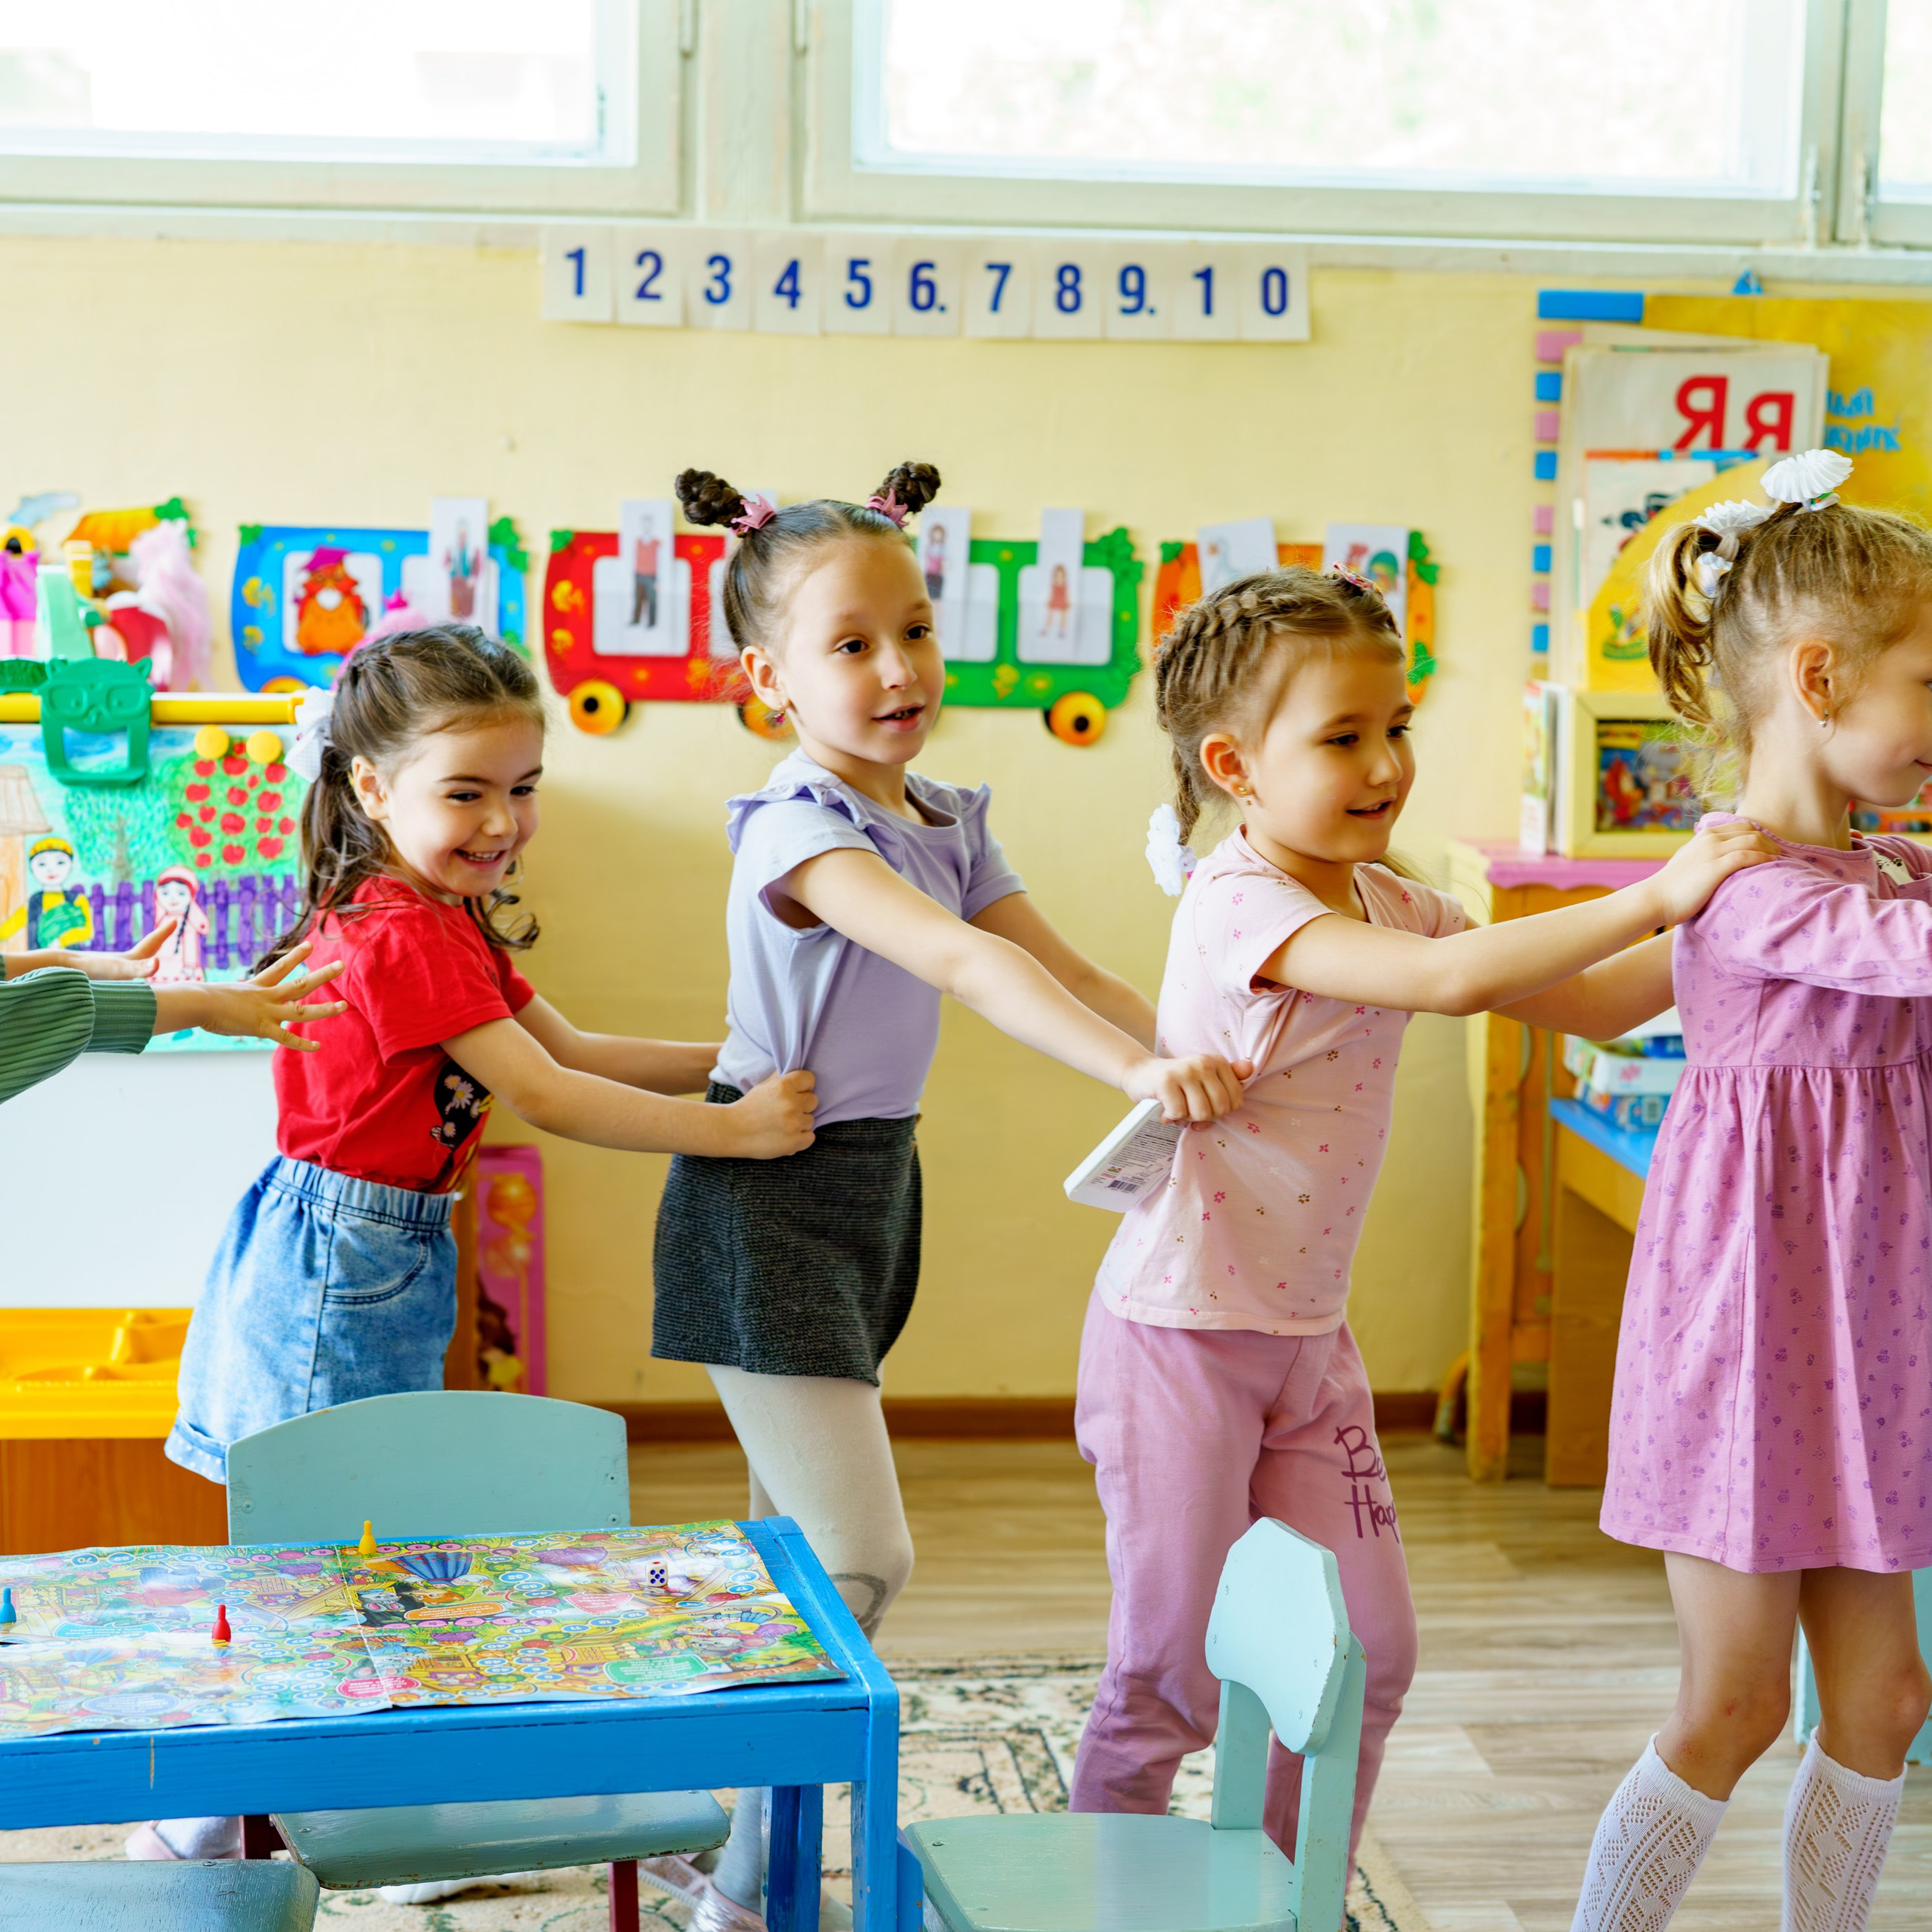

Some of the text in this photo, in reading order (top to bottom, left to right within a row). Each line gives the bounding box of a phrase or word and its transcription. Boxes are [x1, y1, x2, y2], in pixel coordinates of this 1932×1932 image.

[565, 248, 585, 297] 1
[635, 251, 663, 300] 2
[704, 254, 732, 306] 3
[774, 260, 801, 309] 4
[844, 259, 872, 310] 5
[986, 263, 1012, 313] 7
[1056, 263, 1082, 315] 8
[1673, 375, 1728, 451] Я
[1742, 392, 1795, 452] я
[1334, 1425, 1386, 1483] Be
